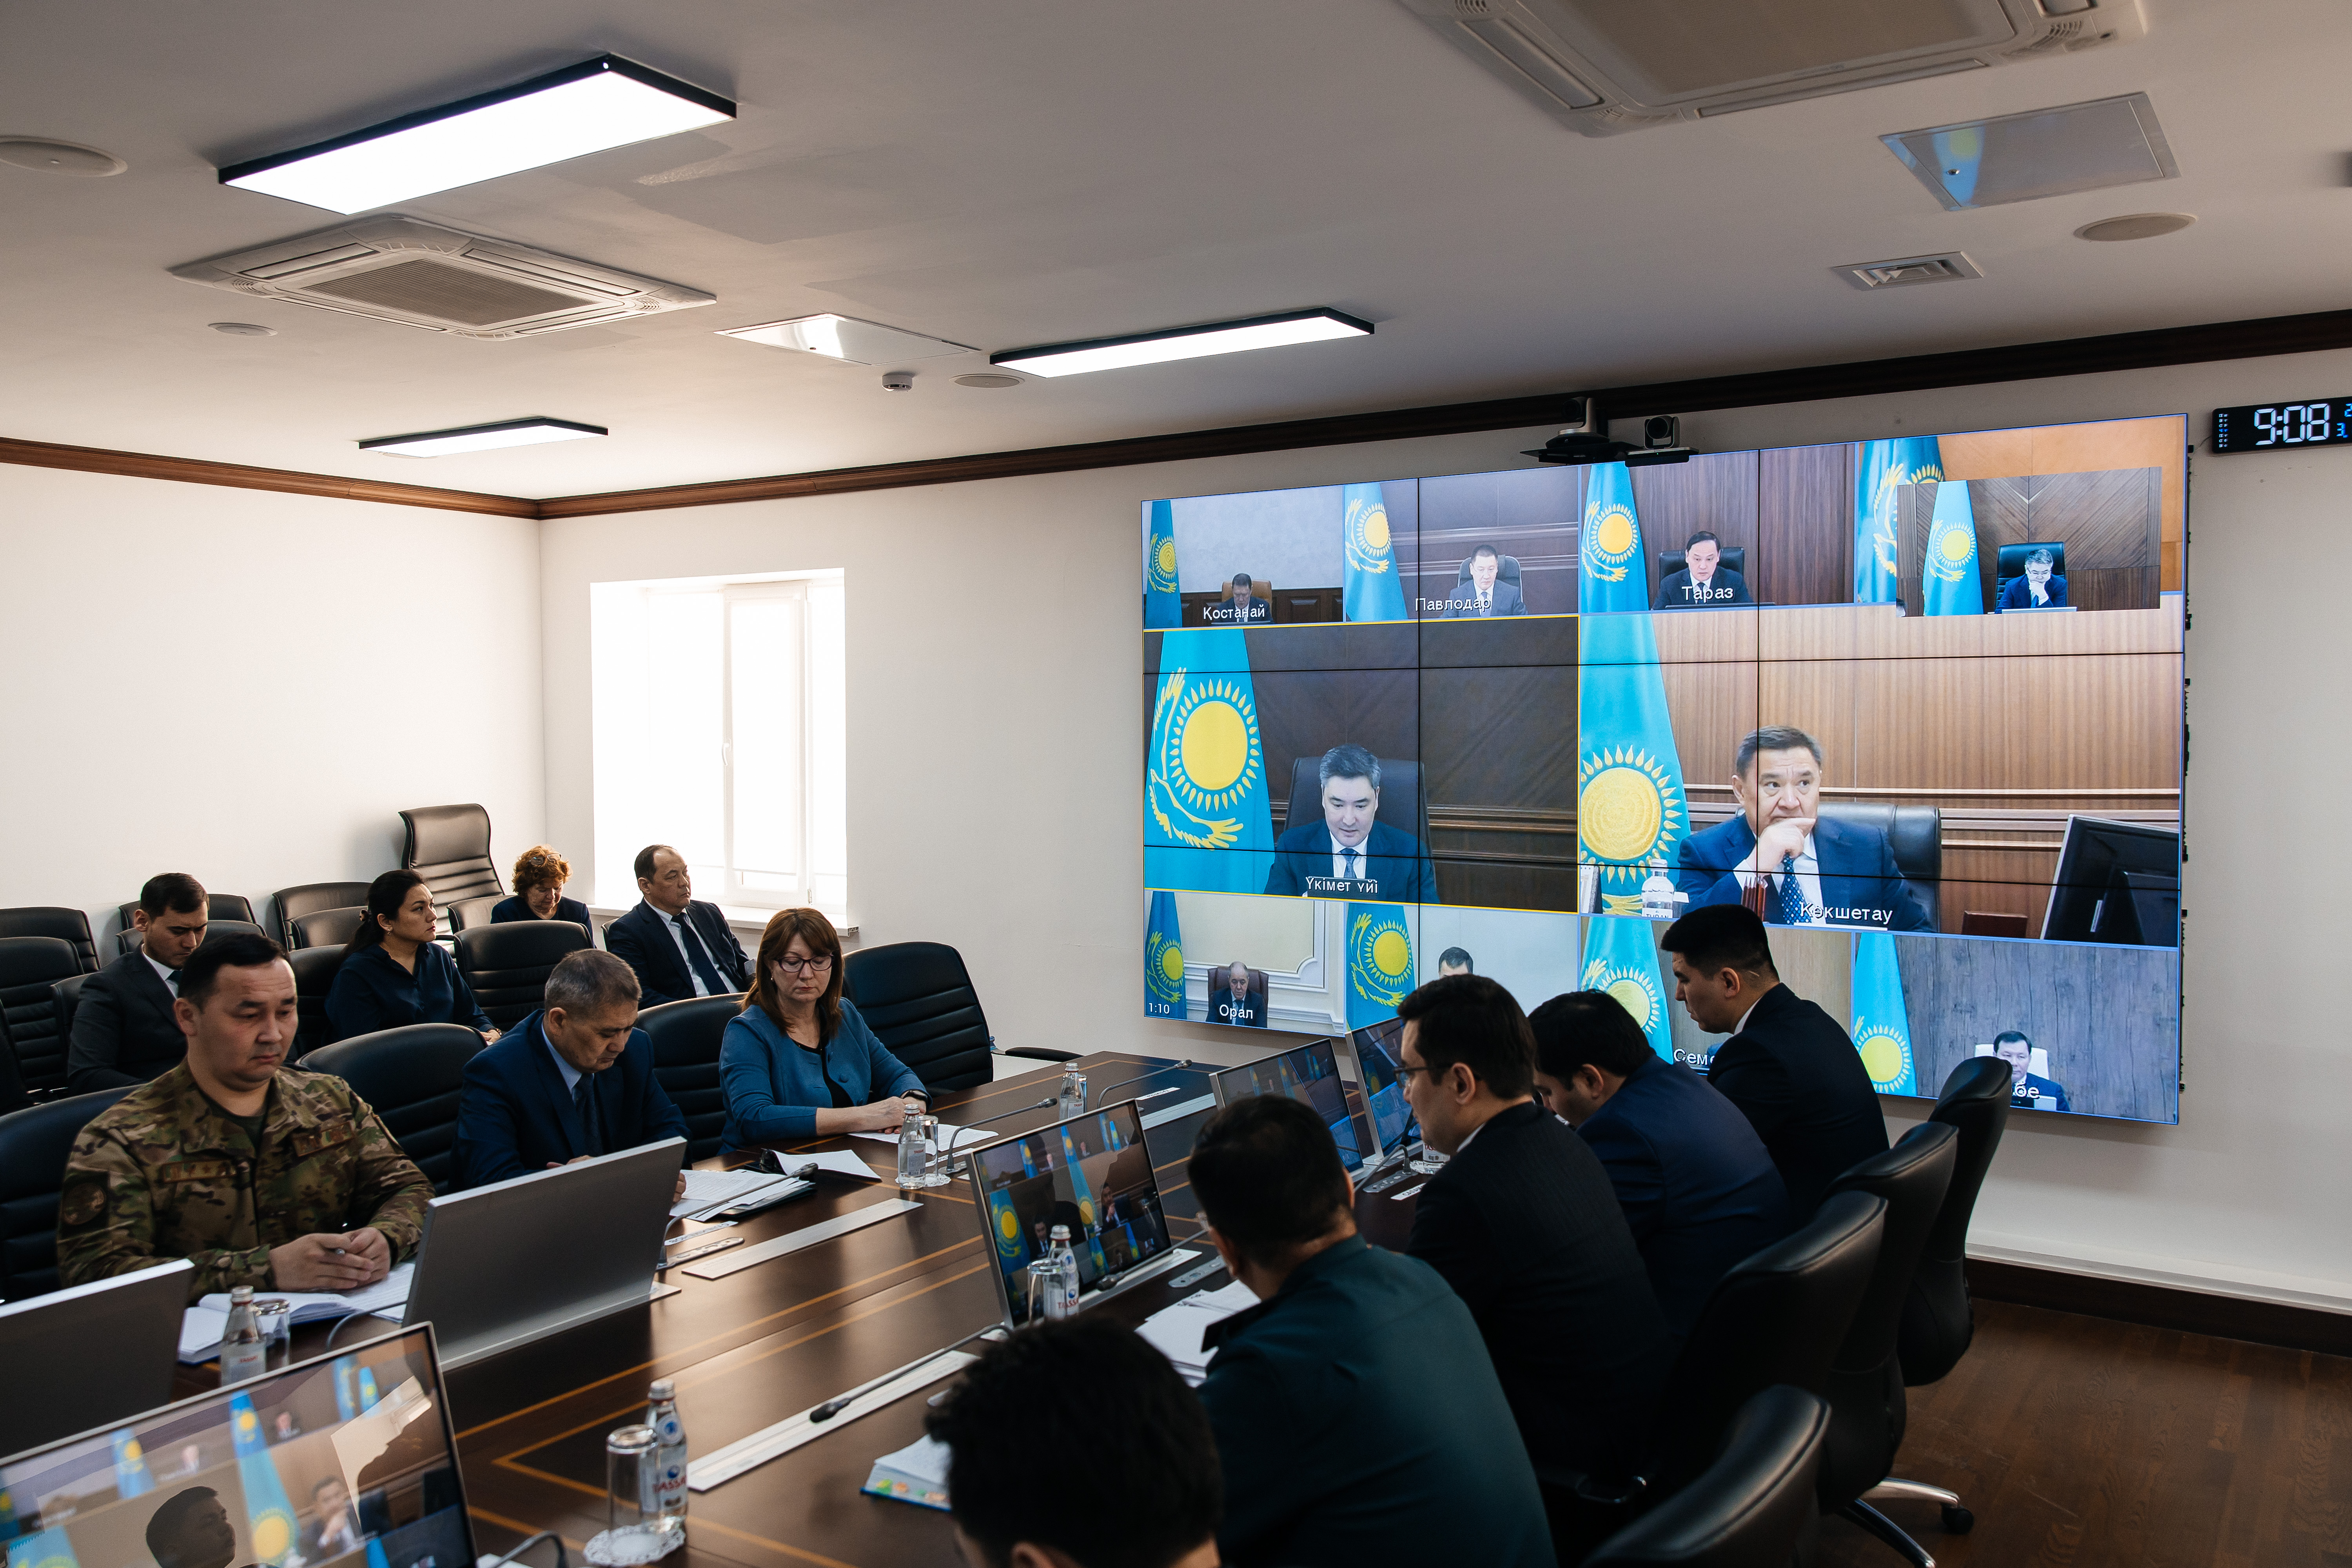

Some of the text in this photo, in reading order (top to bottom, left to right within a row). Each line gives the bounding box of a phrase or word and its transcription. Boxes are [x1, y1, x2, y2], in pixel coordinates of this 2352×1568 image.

[2254, 404, 2330, 445] 9:08
[1681, 586, 1733, 603] Тараз
[1203, 604, 1265, 621] Қостанай
[1415, 597, 1491, 612] Павлодар
[1305, 877, 1377, 893] Үкімет үйі
[1800, 902, 1893, 924] Көкшетау
[1149, 1003, 1170, 1014] 1:10
[1219, 1004, 1253, 1020] Орал
